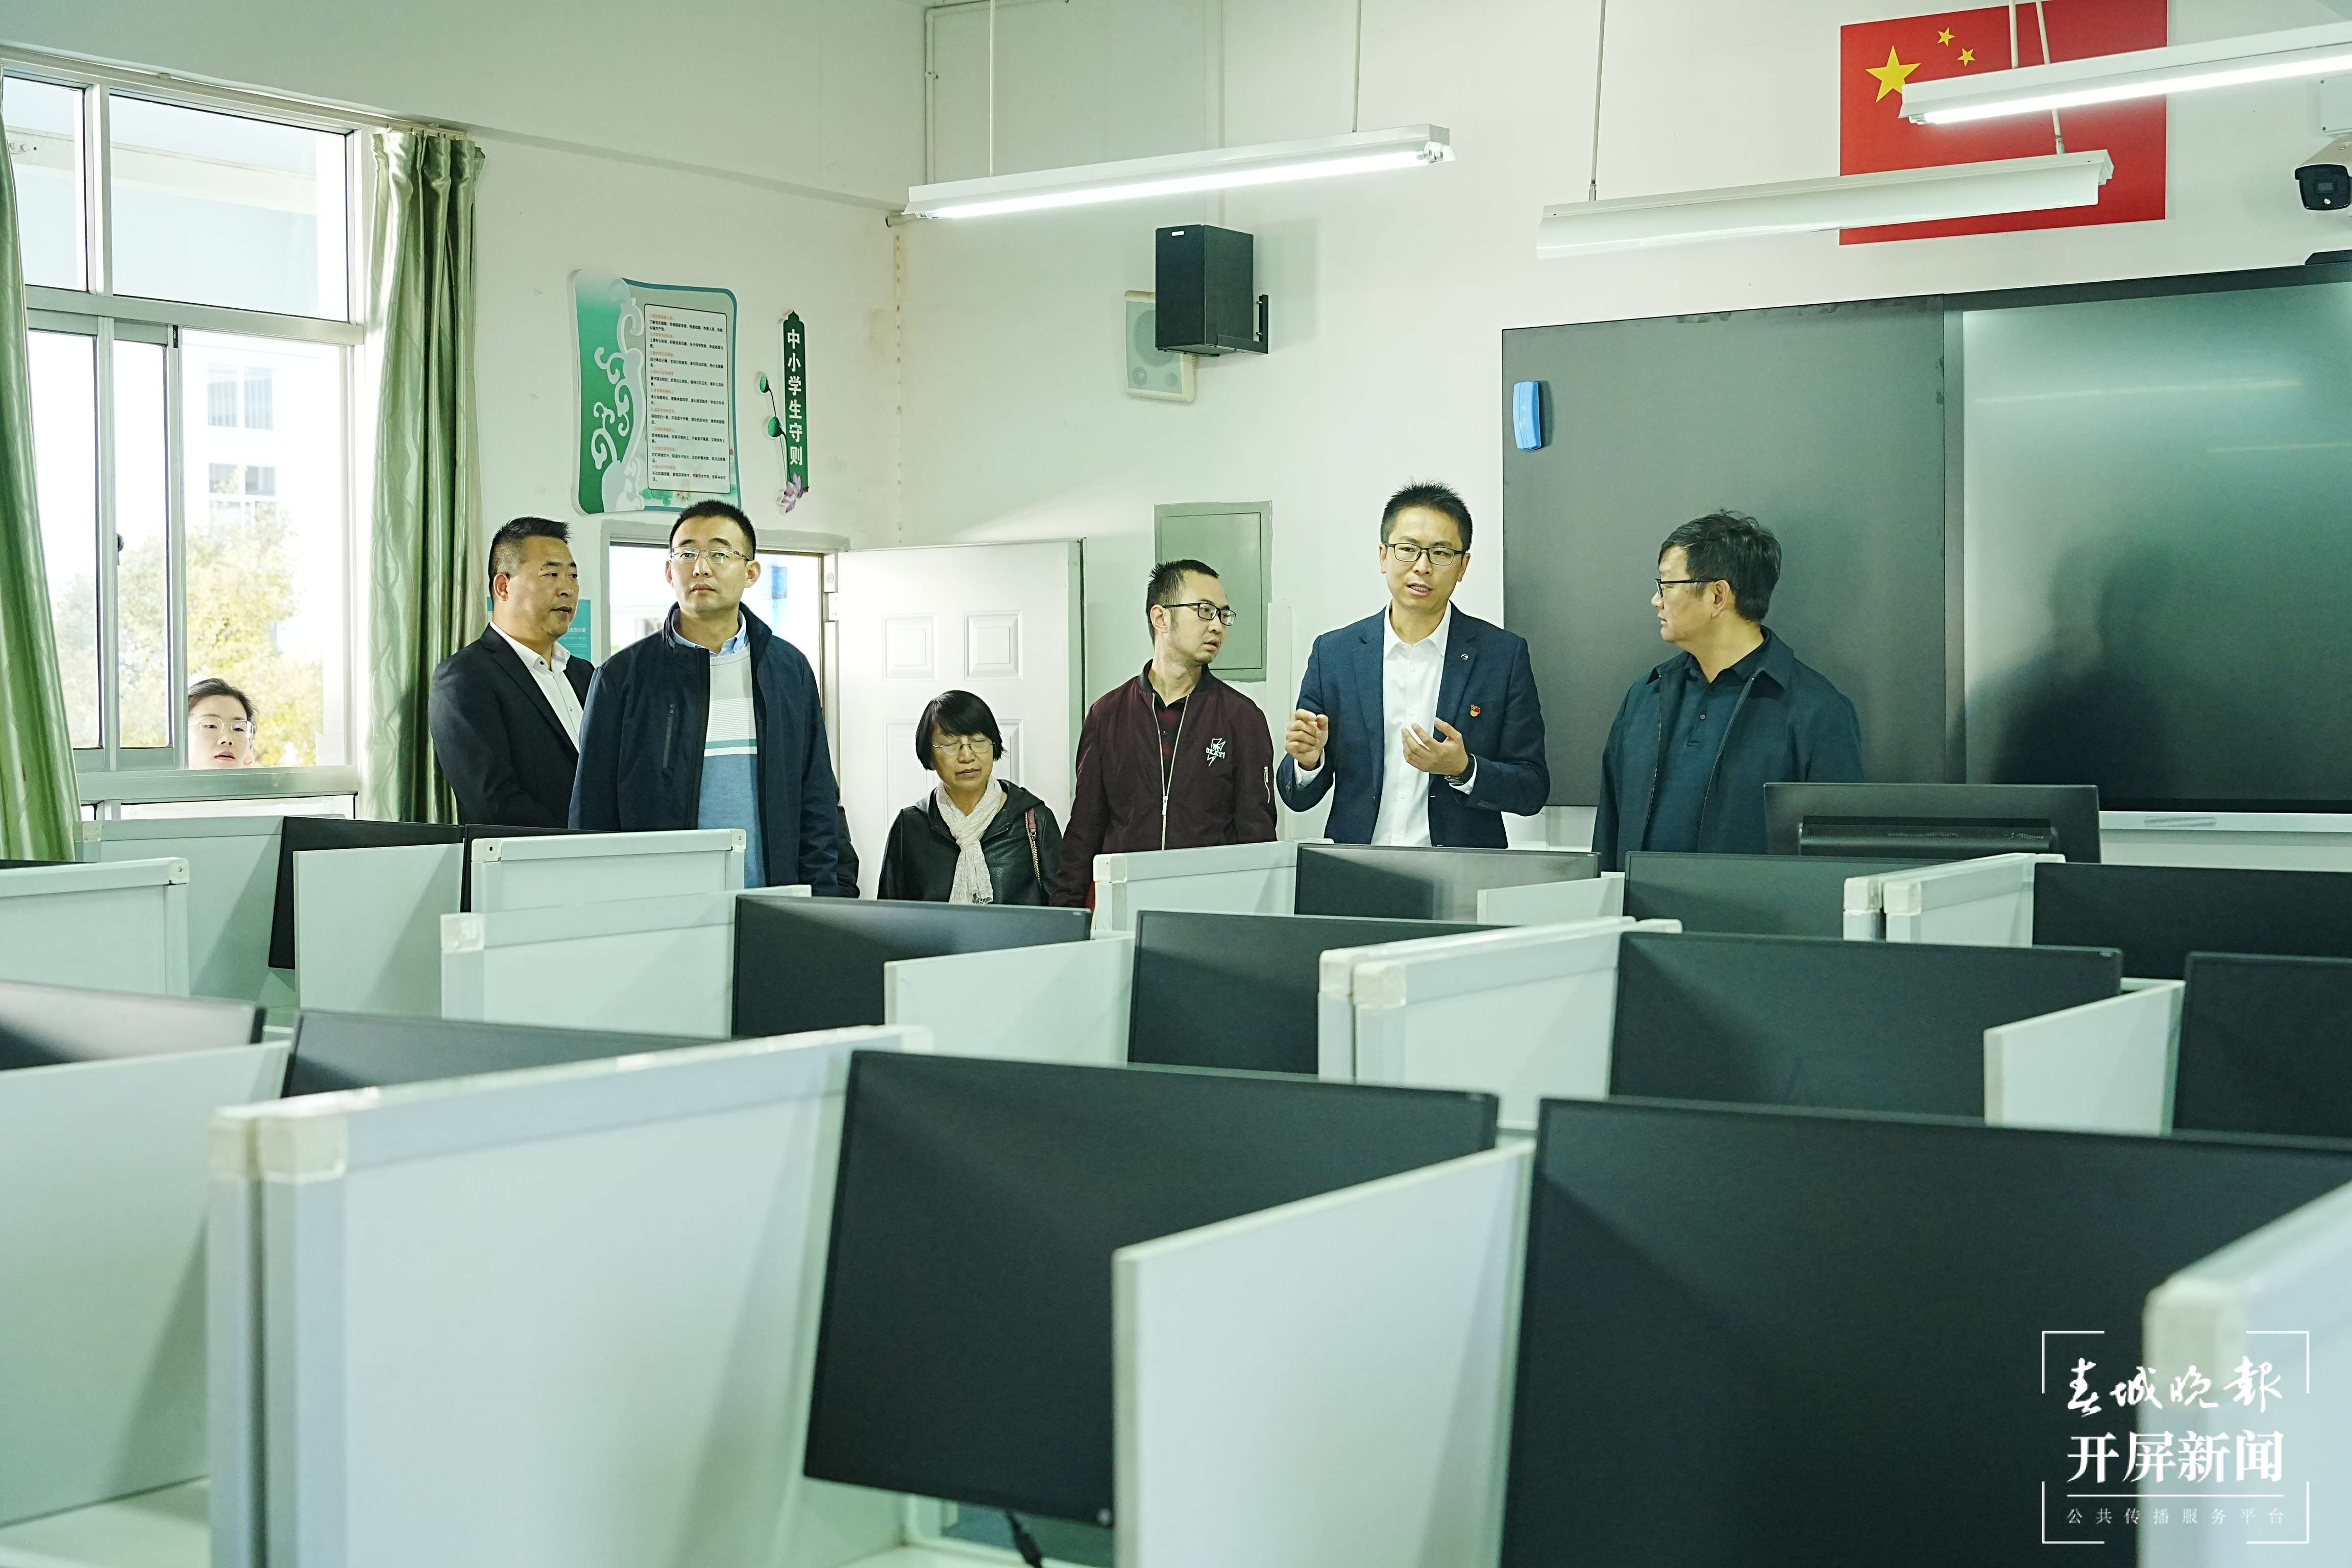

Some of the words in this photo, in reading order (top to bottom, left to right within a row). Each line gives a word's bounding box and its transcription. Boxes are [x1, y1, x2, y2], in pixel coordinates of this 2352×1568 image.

[787, 329, 803, 466] 中小学生守则
